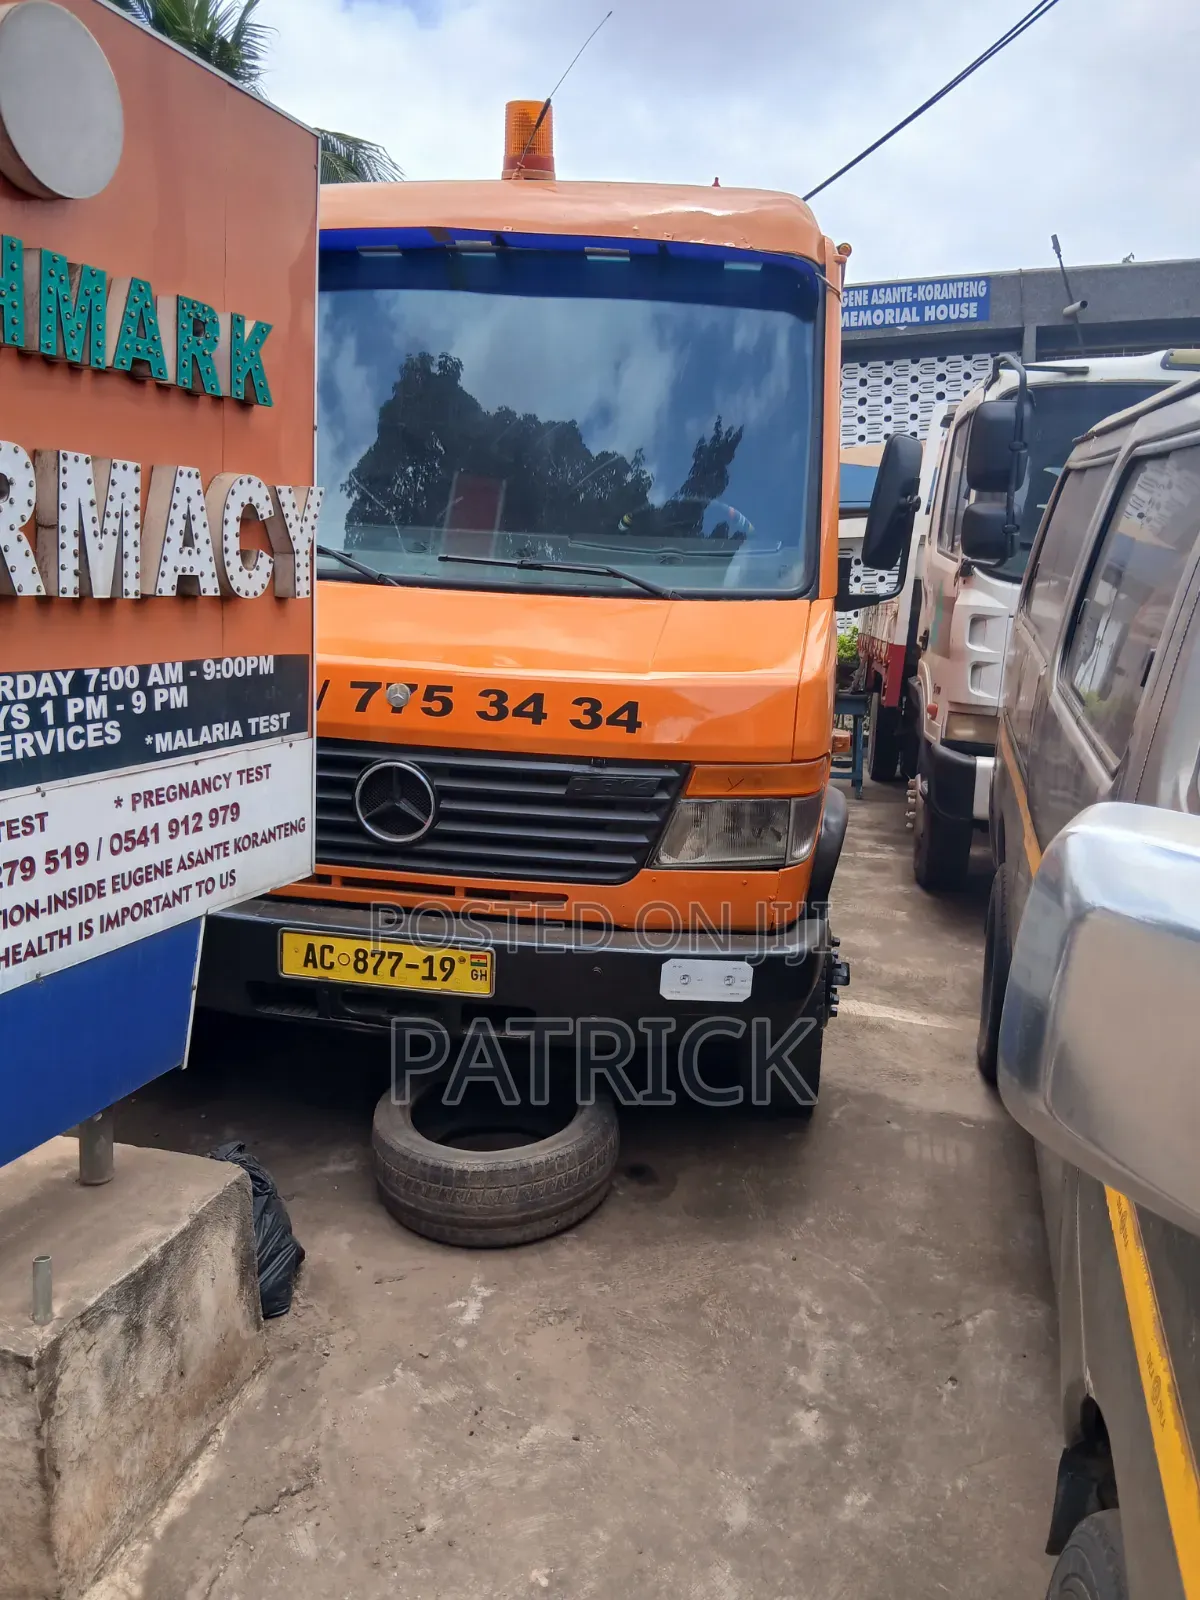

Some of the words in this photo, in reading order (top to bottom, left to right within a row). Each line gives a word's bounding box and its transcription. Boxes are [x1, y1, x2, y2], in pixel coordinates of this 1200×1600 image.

[871, 280, 988, 305] ASANTE-KORANTENG
[924, 302, 978, 322] HOUSE
[84, 665, 140, 693] 7:00
[147, 662, 183, 687] AM
[203, 655, 275, 681] 9:00PM
[40, 700, 54, 726] 1
[67, 695, 108, 723] PM
[131, 690, 147, 714] 9
[154, 685, 189, 712] PM
[248, 712, 291, 737] TEST
[475, 688, 548, 726] 34
[568, 696, 643, 734] 34
[0, 720, 122, 762] ERVICES
[131, 772, 233, 812] PREGNANCY
[236, 764, 272, 786] TEST
[0, 855, 37, 889] 79
[44, 841, 90, 875] 519
[109, 822, 160, 856] 0541
[168, 812, 204, 841] 912
[208, 802, 241, 828] 979
[0, 878, 107, 930] ION-INSIDE
[111, 858, 173, 894] EUGENE
[176, 840, 230, 873] ASANTE
[234, 816, 306, 854] KORANTENG
[78, 918, 94, 941] IS
[99, 884, 193, 934] IMPORTANT
[195, 876, 216, 898] TO
[219, 869, 237, 890] US
[303, 943, 335, 970] AC
[353, 948, 456, 982] 877-19
[470, 968, 488, 982] GH
